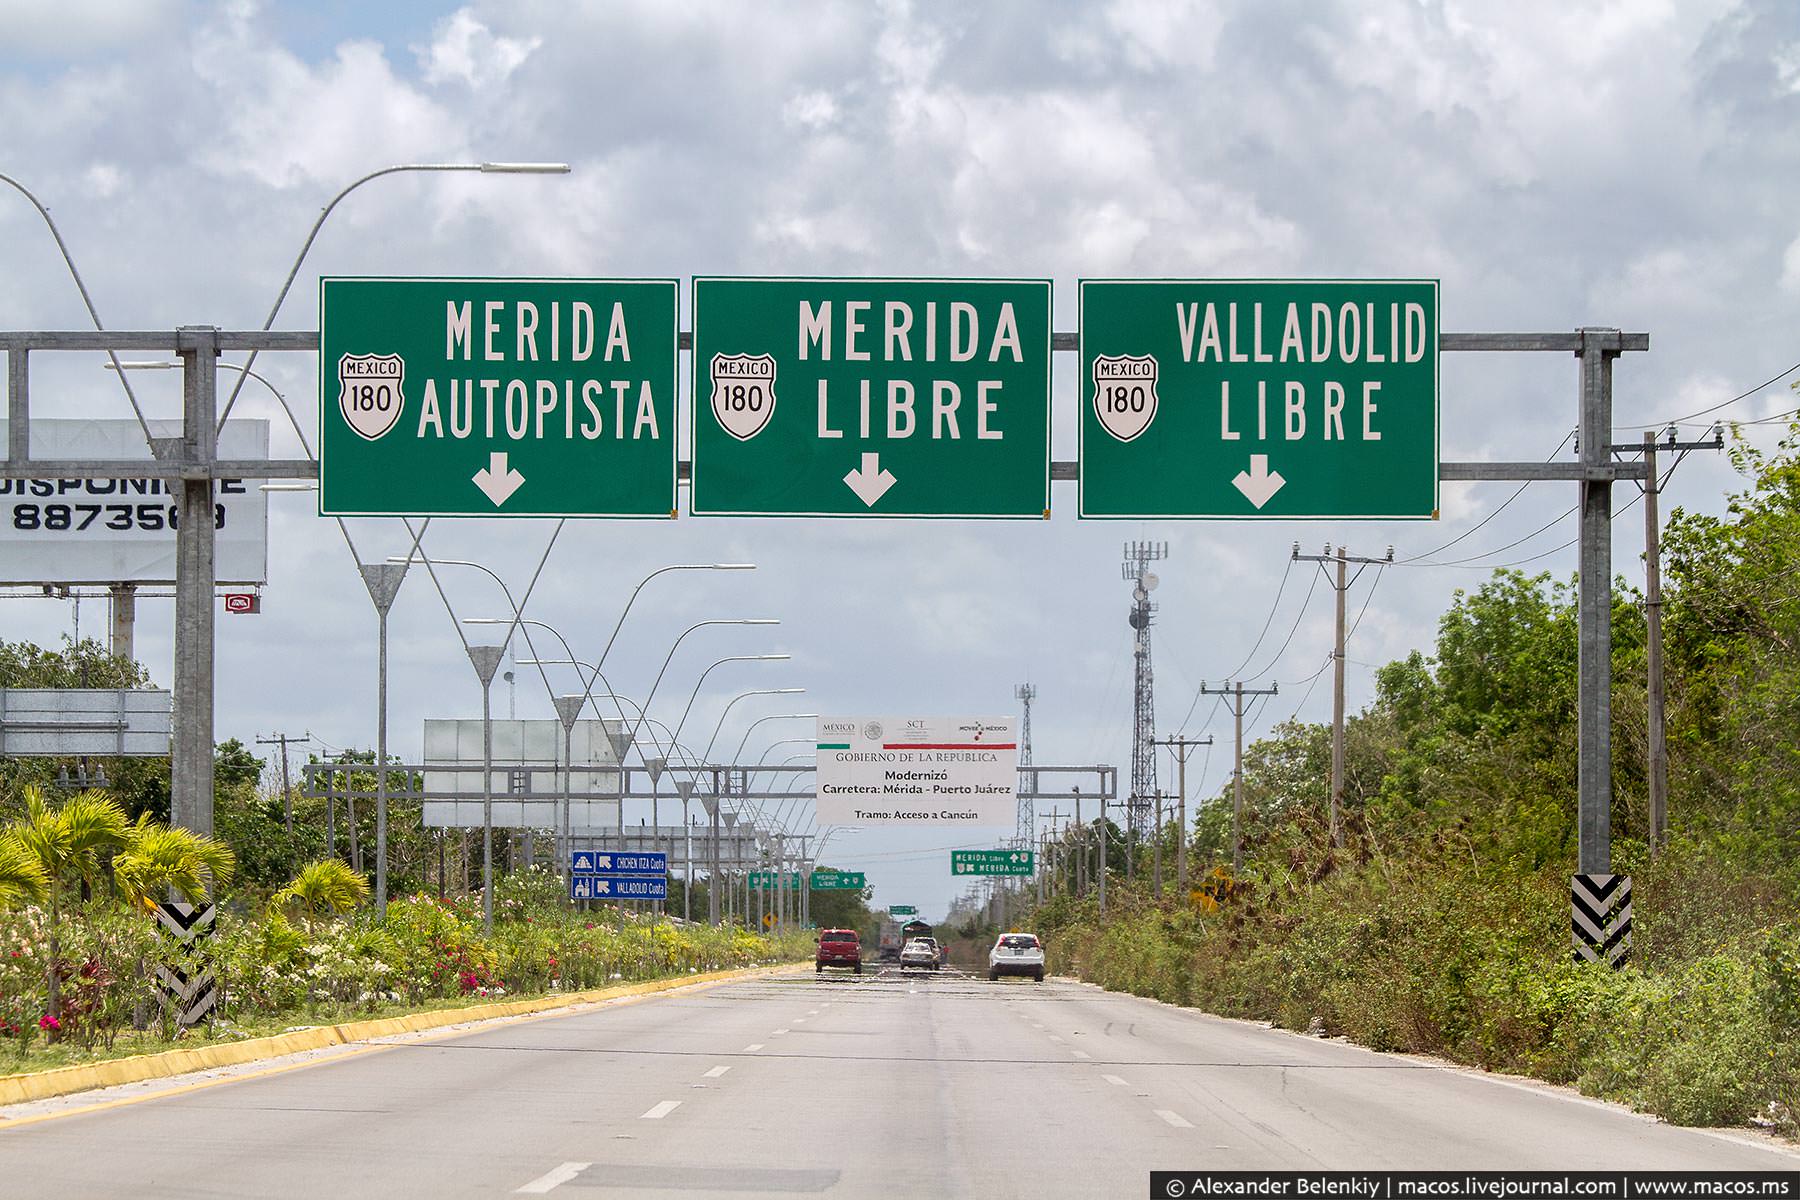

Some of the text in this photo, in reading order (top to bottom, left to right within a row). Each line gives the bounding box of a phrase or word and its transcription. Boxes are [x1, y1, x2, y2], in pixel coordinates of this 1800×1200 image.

[447, 300, 631, 362] MERIDA
[798, 300, 1024, 362] MERIDA
[1176, 302, 1426, 363] VALLADOLID
[346, 361, 397, 375] MEXICO
[718, 361, 769, 376] MEXICO
[1100, 362, 1151, 376] MEXICO
[351, 384, 392, 412] 180
[723, 385, 763, 412] 180
[1105, 386, 1145, 413] 180
[417, 378, 660, 440] AUTOPISTA
[817, 379, 1004, 440] LIBRE
[1221, 380, 1382, 441] LIBRE
[907, 720, 925, 728] SCT
[836, 752, 896, 762] GOBIERNO
[899, 753, 914, 762] DE
[919, 753, 933, 762] LA
[885, 769, 948, 781] Modernizó
[822, 784, 881, 794] Carretera:
[883, 784, 924, 794] Mérida
[933, 785, 972, 794] Puerto
[974, 784, 1011, 794] Juárez
[854, 809, 978, 820] Tramo: Acceso a Cancún
[617, 857, 638, 869] CHICHEN
[956, 854, 987, 862] MERIDA
[617, 882, 648, 894] VALLADOLID
